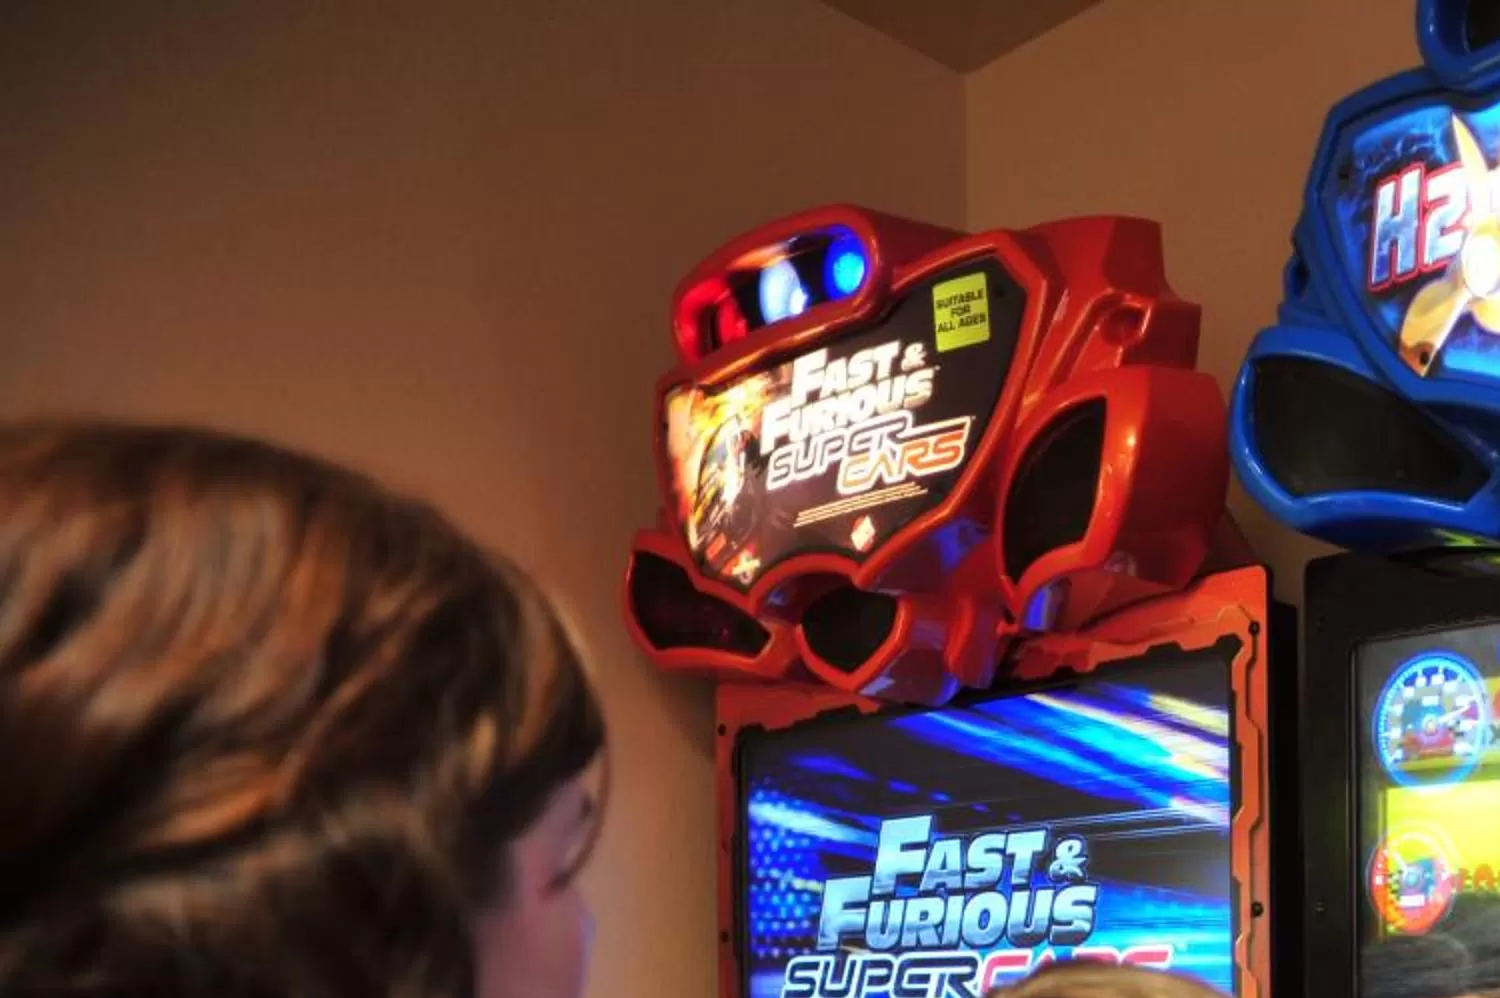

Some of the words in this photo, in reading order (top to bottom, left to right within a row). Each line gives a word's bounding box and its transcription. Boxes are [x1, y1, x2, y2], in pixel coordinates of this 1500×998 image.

[935, 288, 985, 309] SUITABLE
[938, 320, 956, 333] ALL
[959, 312, 986, 328] AGES
[951, 304, 971, 318] FOR
[791, 340, 901, 401] FAST
[901, 342, 927, 371] &
[760, 368, 935, 457] FURIOUS
[766, 410, 914, 491] SUPER
[872, 815, 1048, 895] FAST
[1048, 836, 1089, 884] &
[816, 876, 1099, 952] FURIOUS
